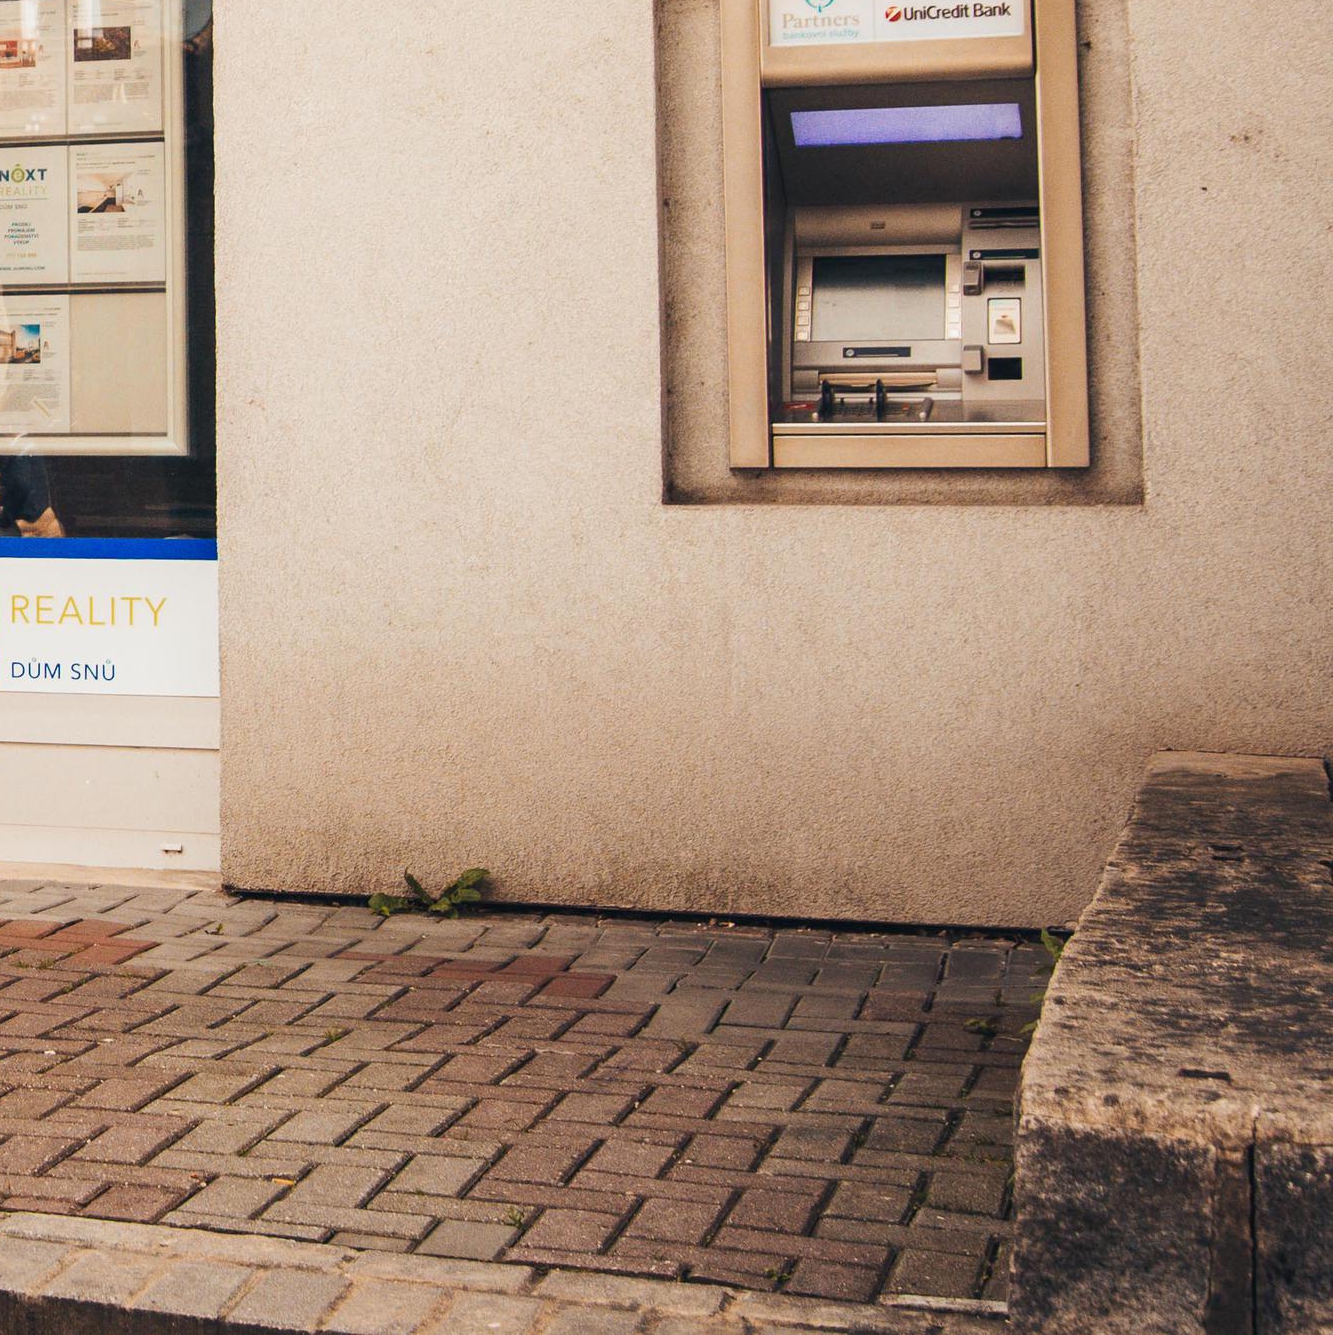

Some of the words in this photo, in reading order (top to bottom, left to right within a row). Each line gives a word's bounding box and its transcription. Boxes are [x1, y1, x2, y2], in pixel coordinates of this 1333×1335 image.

[782, 12, 860, 29] Partners
[904, 3, 970, 21] UniCredit
[973, 1, 1012, 18] Bank
[10, 594, 167, 627] REALITY
[11, 656, 62, 680] DŮM
[70, 658, 116, 682] SNŮ
